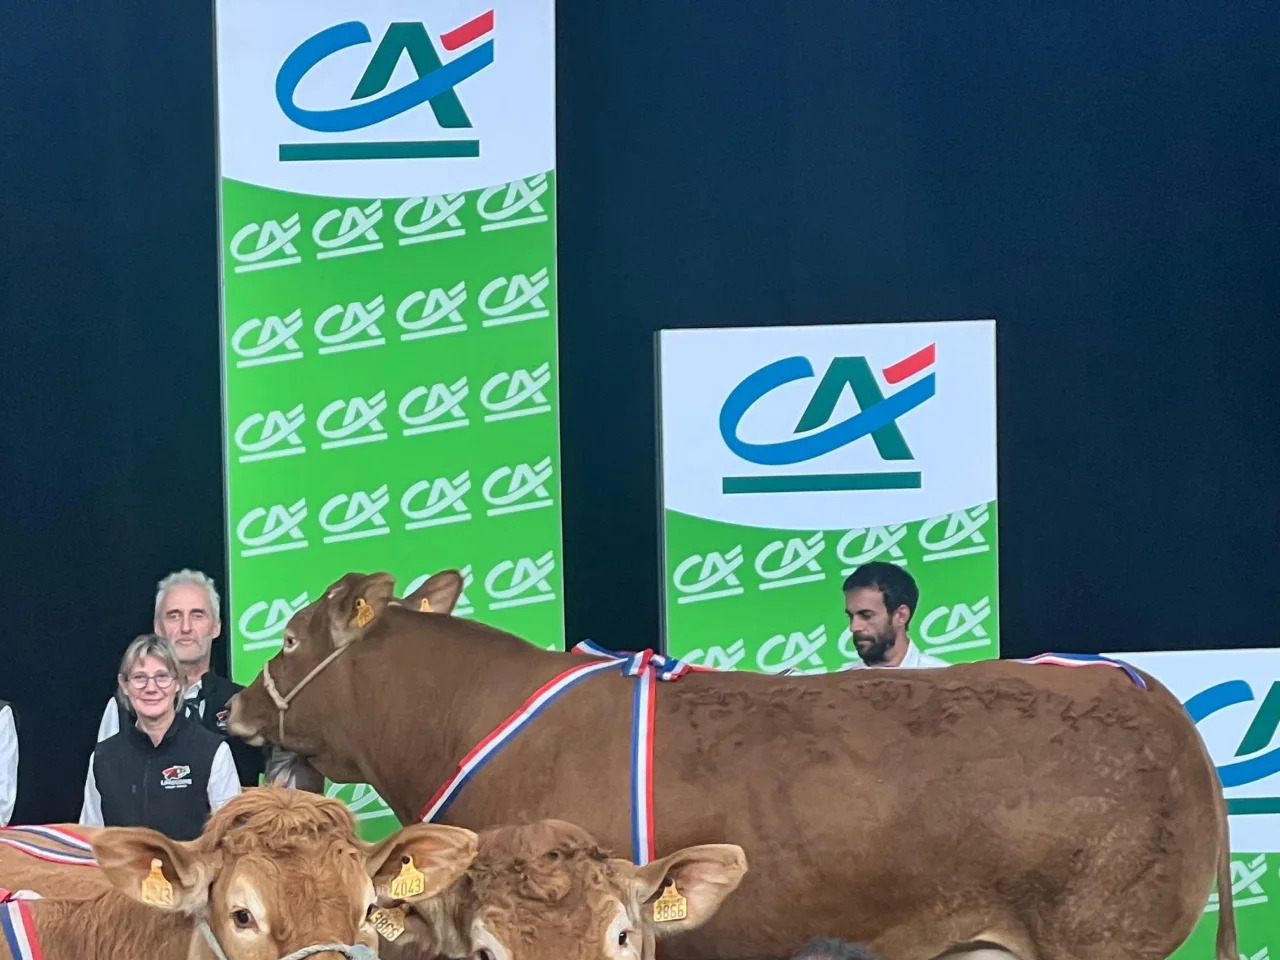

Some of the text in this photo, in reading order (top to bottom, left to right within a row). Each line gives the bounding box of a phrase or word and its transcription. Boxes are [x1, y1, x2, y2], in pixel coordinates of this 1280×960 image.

[275, 9, 494, 132] CA
[230, 173, 548, 262] CA CA CA CA
[231, 267, 549, 357] CA CA CA CA
[234, 362, 551, 453] CA CA CA CA
[719, 342, 936, 466] CA
[237, 457, 553, 546] CA CA CA CA
[484, 551, 554, 599] CA
[673, 503, 989, 593] CA CA CA CA
[920, 596, 991, 644] CA
[394, 880, 422, 897] 4043
[656, 904, 684, 920] 3866
